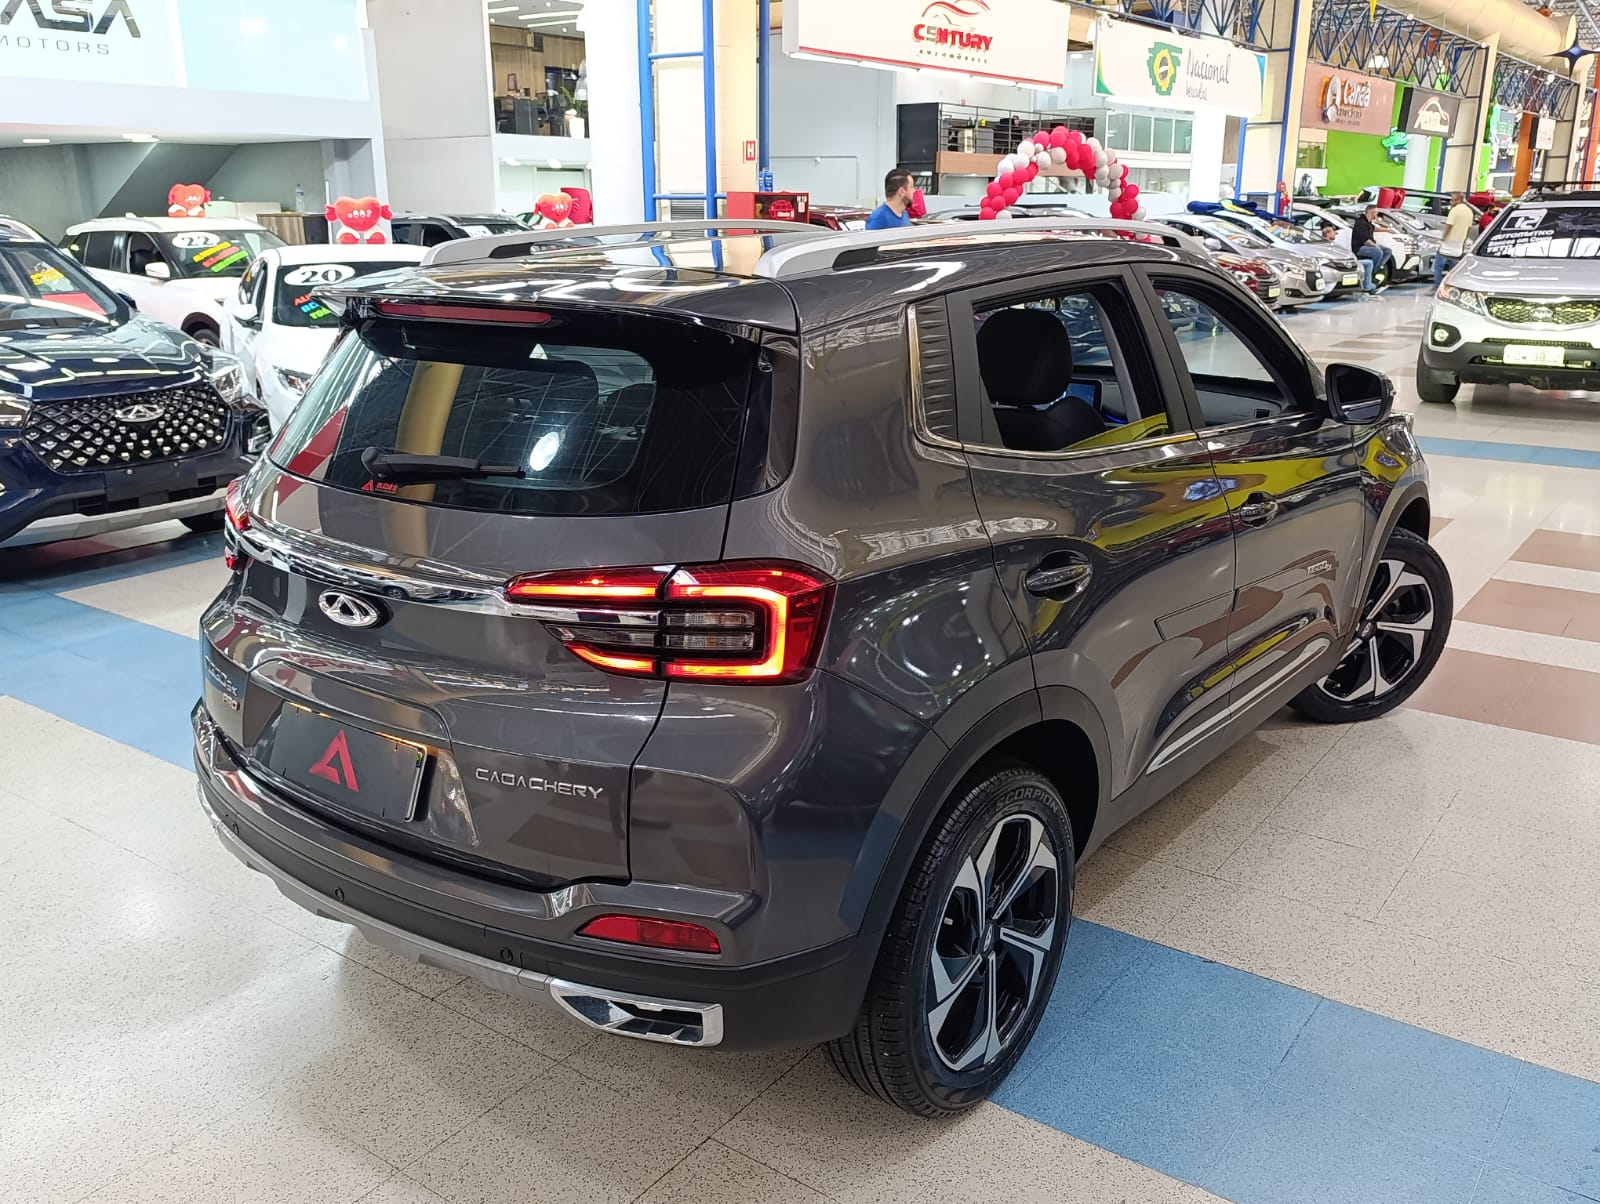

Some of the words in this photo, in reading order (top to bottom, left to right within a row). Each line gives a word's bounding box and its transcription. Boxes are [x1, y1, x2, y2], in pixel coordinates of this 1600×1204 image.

[913, 23, 993, 51] CENTURY
[1186, 48, 1231, 84] Nacional
[300, 269, 342, 284] 20
[996, 787, 1060, 814] SCORPION
